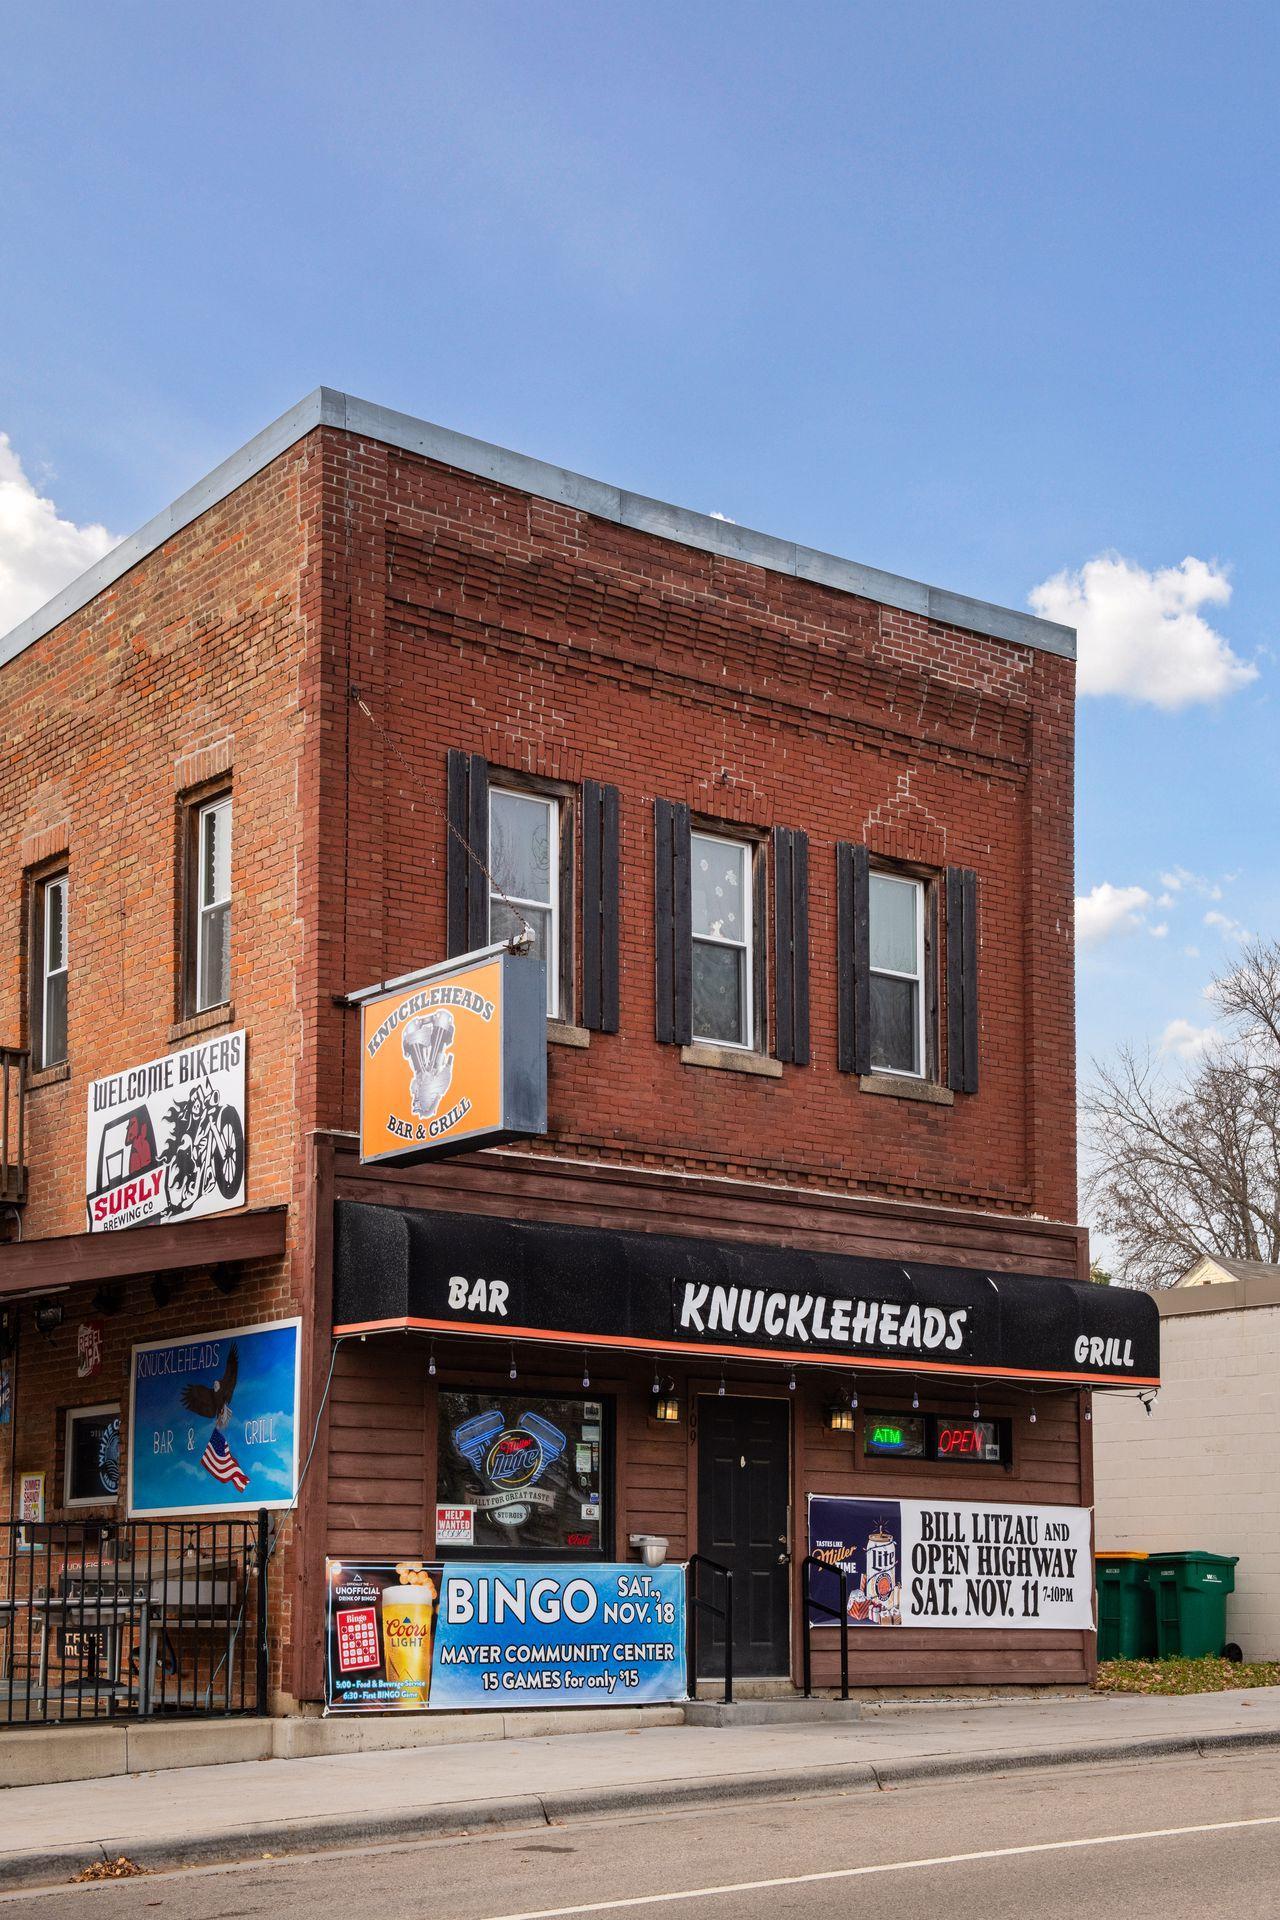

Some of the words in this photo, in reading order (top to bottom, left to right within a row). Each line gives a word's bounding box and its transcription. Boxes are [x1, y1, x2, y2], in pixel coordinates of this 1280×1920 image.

[367, 986, 495, 1057] KNUCKLEHEADS
[93, 1058, 174, 1112] WELCOME
[179, 1035, 241, 1085] BIKERS
[387, 1115, 413, 1140] BAR
[415, 1125, 426, 1140] &
[429, 1098, 471, 1137] GRILL
[94, 1168, 165, 1222] SURLY
[103, 1206, 141, 1231] BREWING
[448, 1276, 509, 1316] BAR
[680, 1282, 967, 1350] KNUCKLEHEADS
[137, 1343, 220, 1379] KNUCKLEHEADS
[1074, 1334, 1135, 1368] GRILL
[99, 1423, 114, 1468] WHITE
[153, 1431, 174, 1454] BAR
[187, 1428, 195, 1450] &
[244, 1417, 277, 1446] GRILL
[873, 1428, 901, 1444] ATM
[939, 1429, 983, 1452] OPEN
[490, 1449, 540, 1479] Lite
[469, 1497, 491, 1507] RALLY
[491, 1496, 505, 1504] FOR
[505, 1491, 529, 1501] GREAT
[439, 1520, 470, 1531] WANTED
[445, 1510, 465, 1520] HELP
[497, 1511, 523, 1519] STURGIS
[920, 1511, 966, 1543] BILL
[972, 1513, 1038, 1546] LITZAU
[1044, 1523, 1070, 1542] AND
[812, 1546, 857, 1571] Miller
[872, 1549, 894, 1571] Lite
[911, 1543, 969, 1576] OPEN
[977, 1546, 1078, 1579] HIGHWAY
[335, 1586, 380, 1595] UNOFFICIAL
[446, 1577, 599, 1625] BINGO
[616, 1575, 661, 1602] SAT.,
[911, 1576, 958, 1617] SAT.
[965, 1579, 1015, 1617] NOV.
[1021, 1580, 1040, 1617] 11
[1042, 1585, 1074, 1603] 7-10PM
[346, 1614, 367, 1624] Bingo
[602, 1602, 652, 1625] NOV.
[656, 1602, 676, 1624] 18
[386, 1618, 428, 1638] Coors
[391, 1638, 423, 1647] LIGHT
[440, 1645, 501, 1665] MAYER
[504, 1643, 611, 1664] COMMUNITY
[612, 1643, 675, 1662] CENTER
[336, 1680, 351, 1689] 5:00
[356, 1680, 371, 1689] Food
[371, 1680, 378, 1688] &
[379, 1679, 404, 1690] Beverage
[482, 1673, 500, 1691] 15
[502, 1671, 562, 1690] GAMES
[564, 1670, 586, 1689] for
[587, 1670, 618, 1694] only
[619, 1669, 640, 1688] $15
[343, 1691, 358, 1700] 6:30
[362, 1691, 377, 1699] First
[377, 1690, 401, 1699] BINGO
